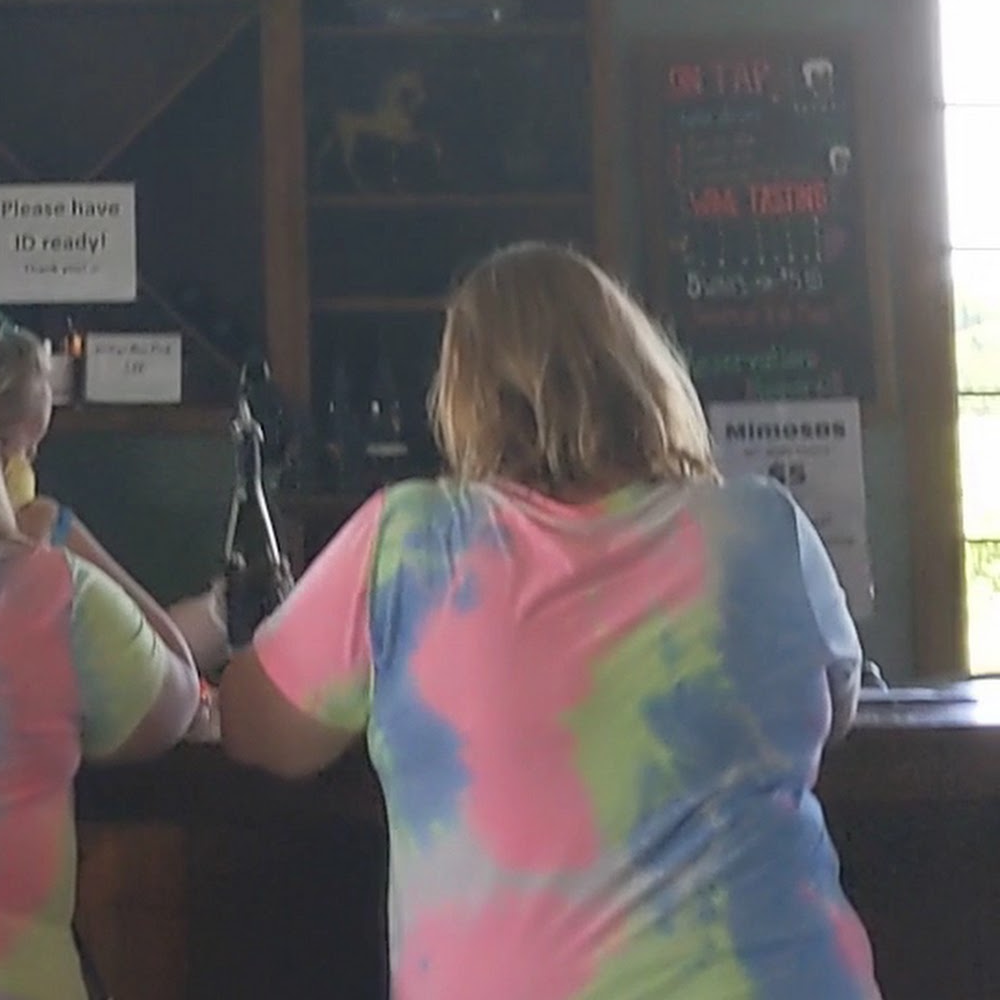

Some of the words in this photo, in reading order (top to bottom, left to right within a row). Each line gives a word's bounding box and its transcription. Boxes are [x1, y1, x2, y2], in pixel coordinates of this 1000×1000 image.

[0, 199, 66, 220] Please
[71, 198, 122, 219] have
[15, 232, 37, 252] ID
[41, 231, 107, 255] ready!
[726, 421, 846, 440] Mimosas
